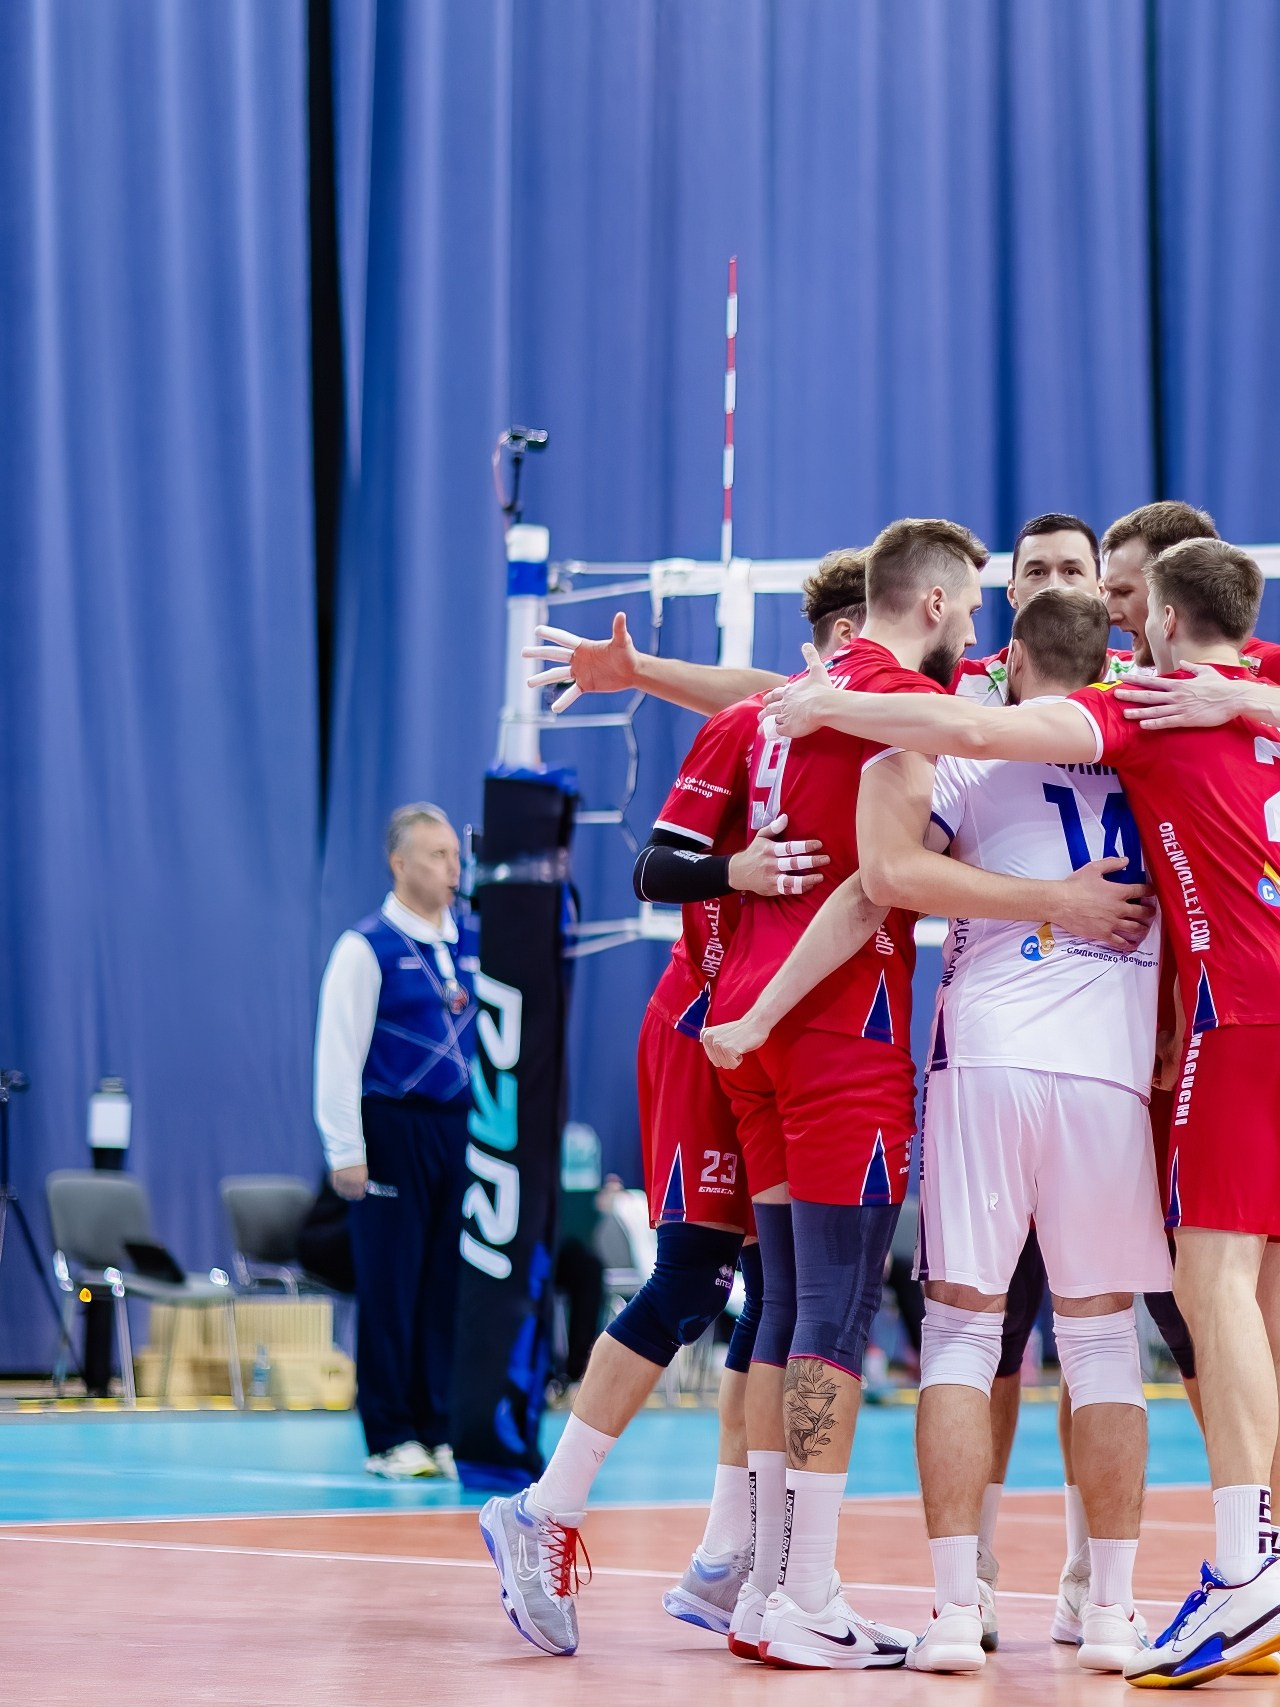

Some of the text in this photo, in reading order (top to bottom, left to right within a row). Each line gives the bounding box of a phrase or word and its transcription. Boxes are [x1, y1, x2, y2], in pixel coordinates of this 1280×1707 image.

[751, 736, 791, 829] 9
[1042, 782, 1146, 884] 14
[1158, 821, 1211, 953] ORENVOLLEY.COM
[700, 1149, 737, 1185] 23
